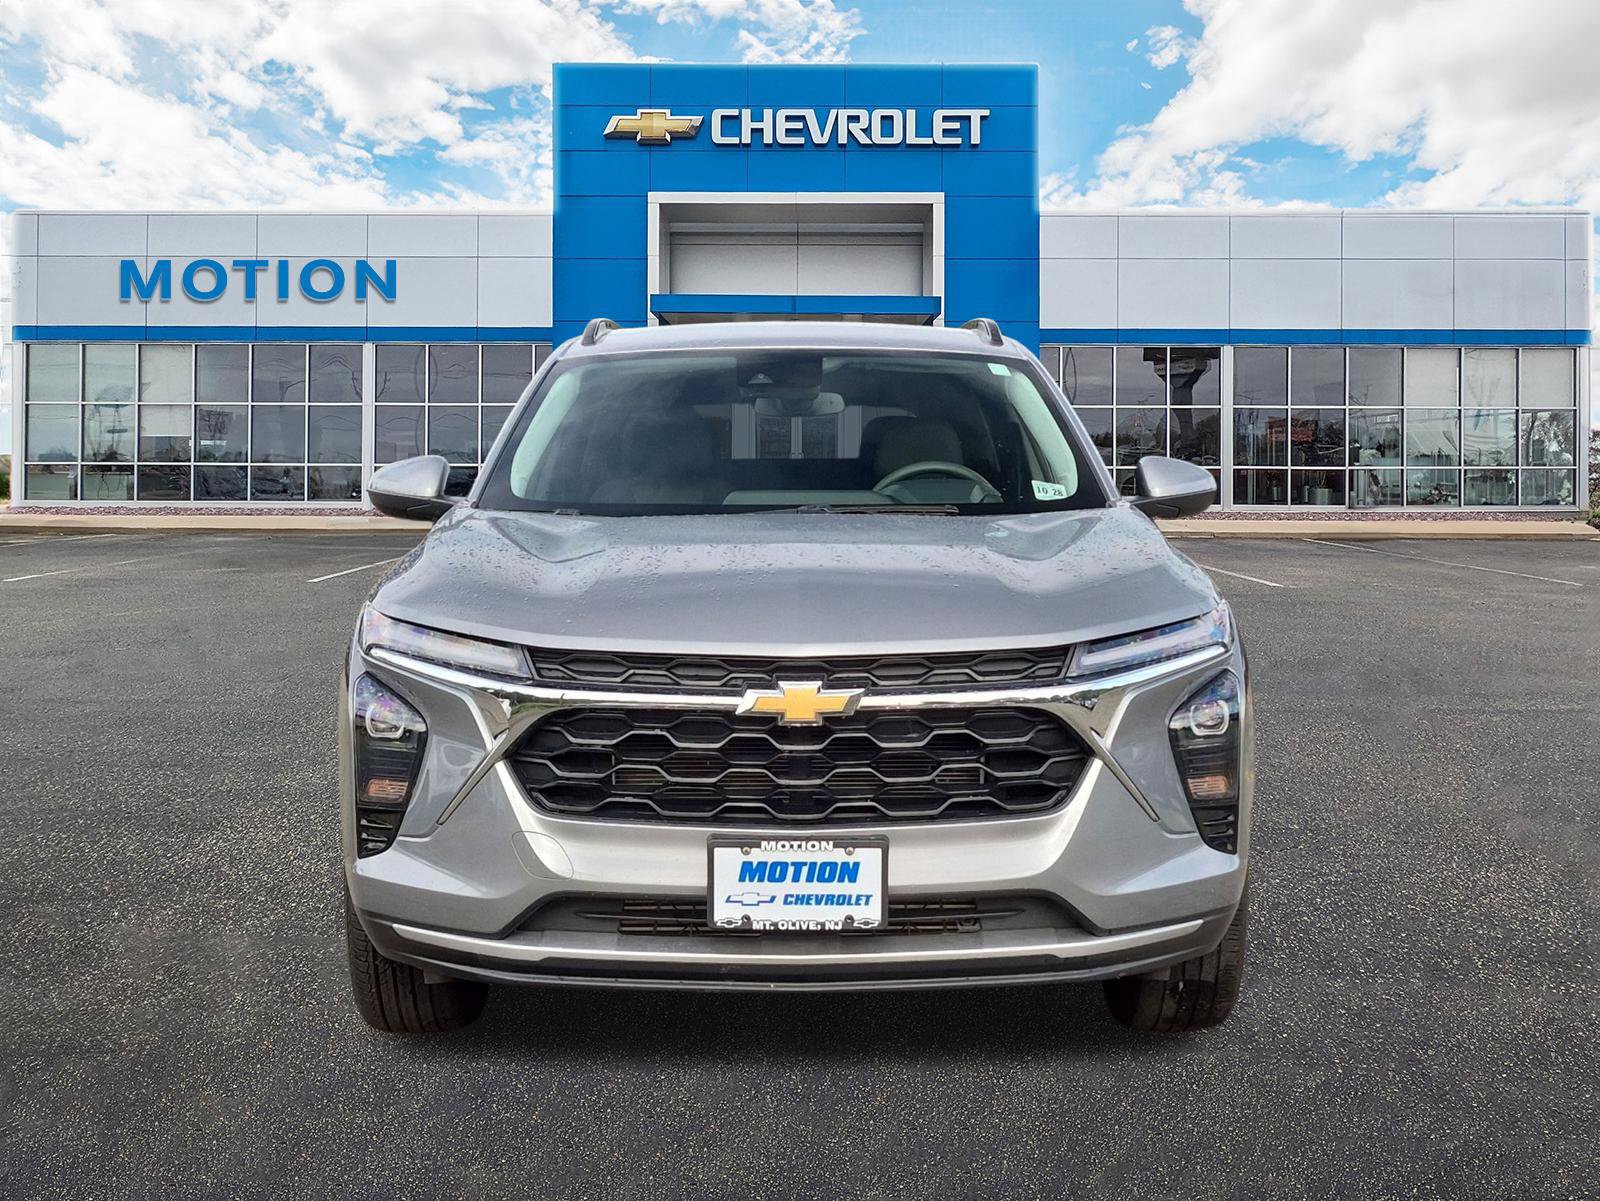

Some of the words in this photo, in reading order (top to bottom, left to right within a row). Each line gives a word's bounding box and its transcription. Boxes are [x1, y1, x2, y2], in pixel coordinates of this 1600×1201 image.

[711, 108, 990, 146] CHEVROLET
[119, 258, 397, 303] MOTION
[1036, 485, 1048, 495] 10
[760, 840, 834, 852] MOTION
[738, 861, 861, 884] MOTION
[782, 893, 873, 907] CHEVROLET
[752, 920, 775, 931] MT.
[781, 920, 822, 931] OLIVE,
[825, 920, 843, 931] NJ
